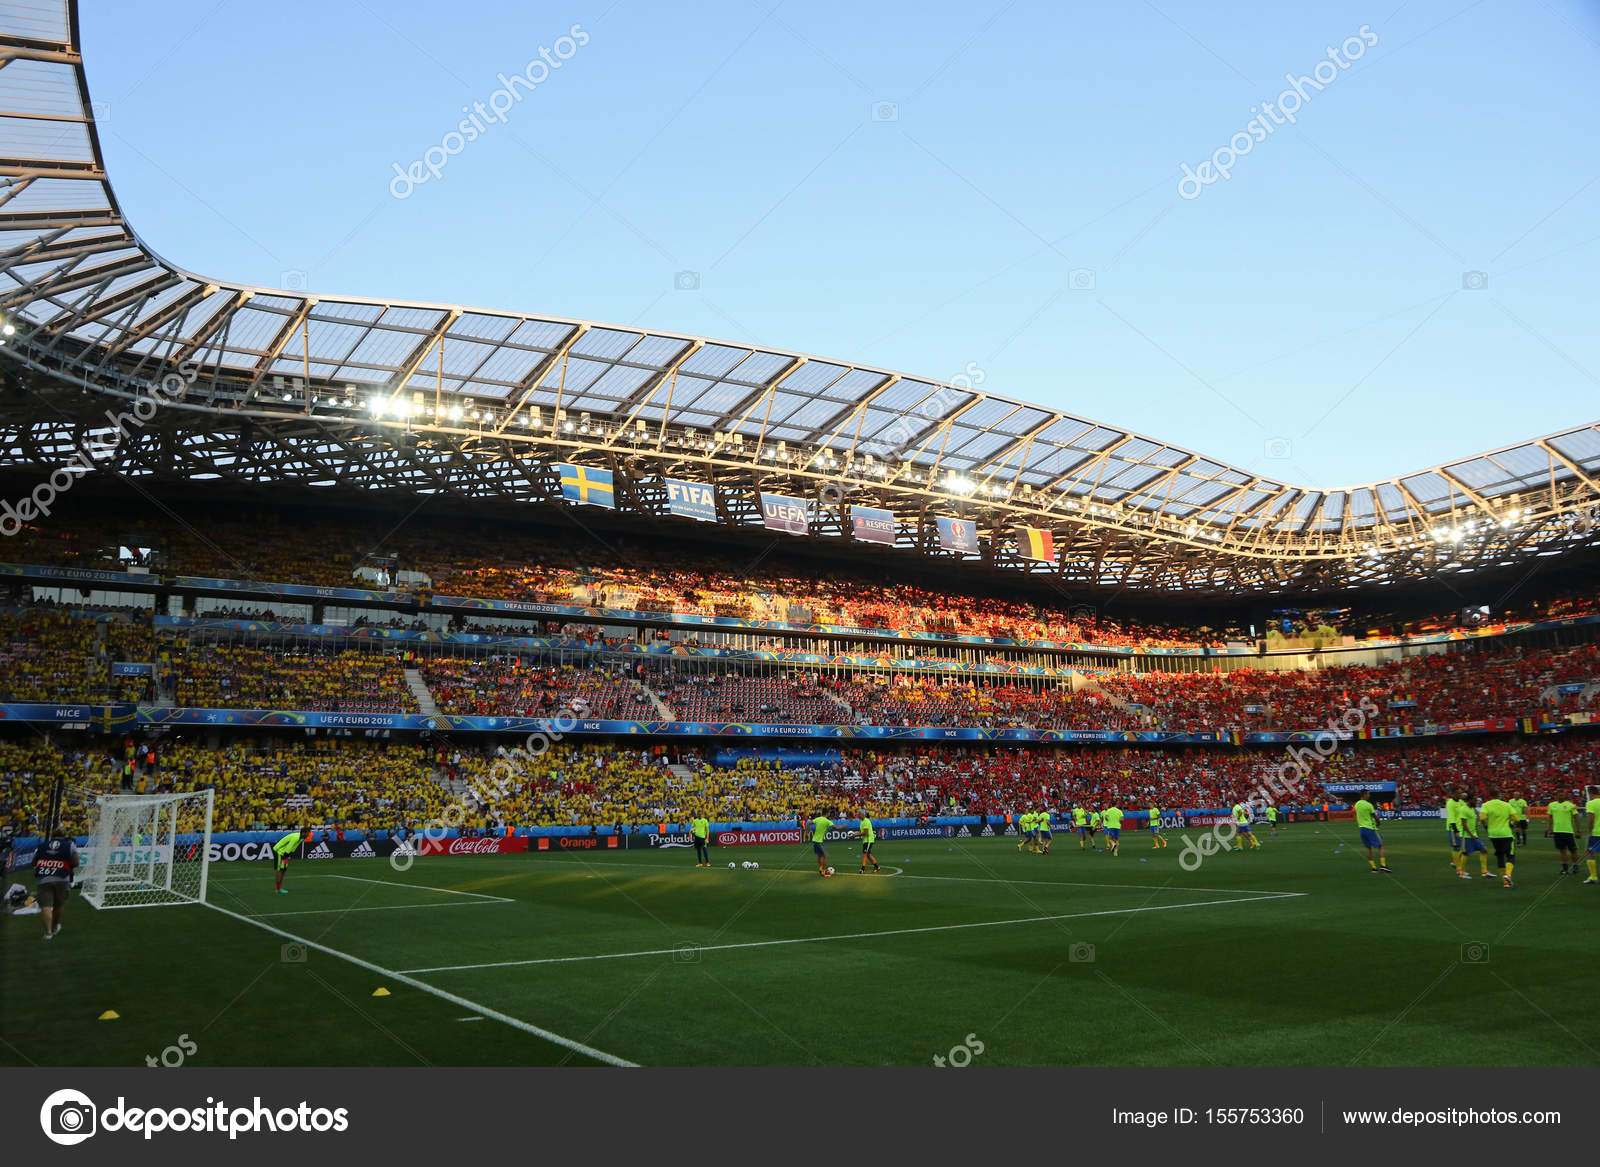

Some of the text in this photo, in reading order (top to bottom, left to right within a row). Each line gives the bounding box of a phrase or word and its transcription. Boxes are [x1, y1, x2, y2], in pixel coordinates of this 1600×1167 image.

[667, 483, 715, 507] FIFA
[765, 503, 806, 523] UEFA
[865, 519, 894, 531] RESPECT
[39, 568, 117, 580] UEFA EURO 2016
[316, 588, 334, 596] NICE
[504, 602, 558, 613] UEFA EURO 2016
[56, 709, 80, 717] NICE
[320, 716, 393, 725] UEFA EURO 2016
[583, 722, 600, 730] NICE
[1158, 816, 1185, 829] OCAR
[739, 831, 800, 843] KIA MOTORS
[892, 827, 942, 837] UEFA EURO 2016
[449, 837, 503, 855] Coca-Cola
[560, 836, 597, 849] Orange
[207, 842, 275, 862] SOCA
[392, 849, 417, 857] adidas
[36, 858, 64, 868] PHOTO
[38, 867, 57, 875] 267
